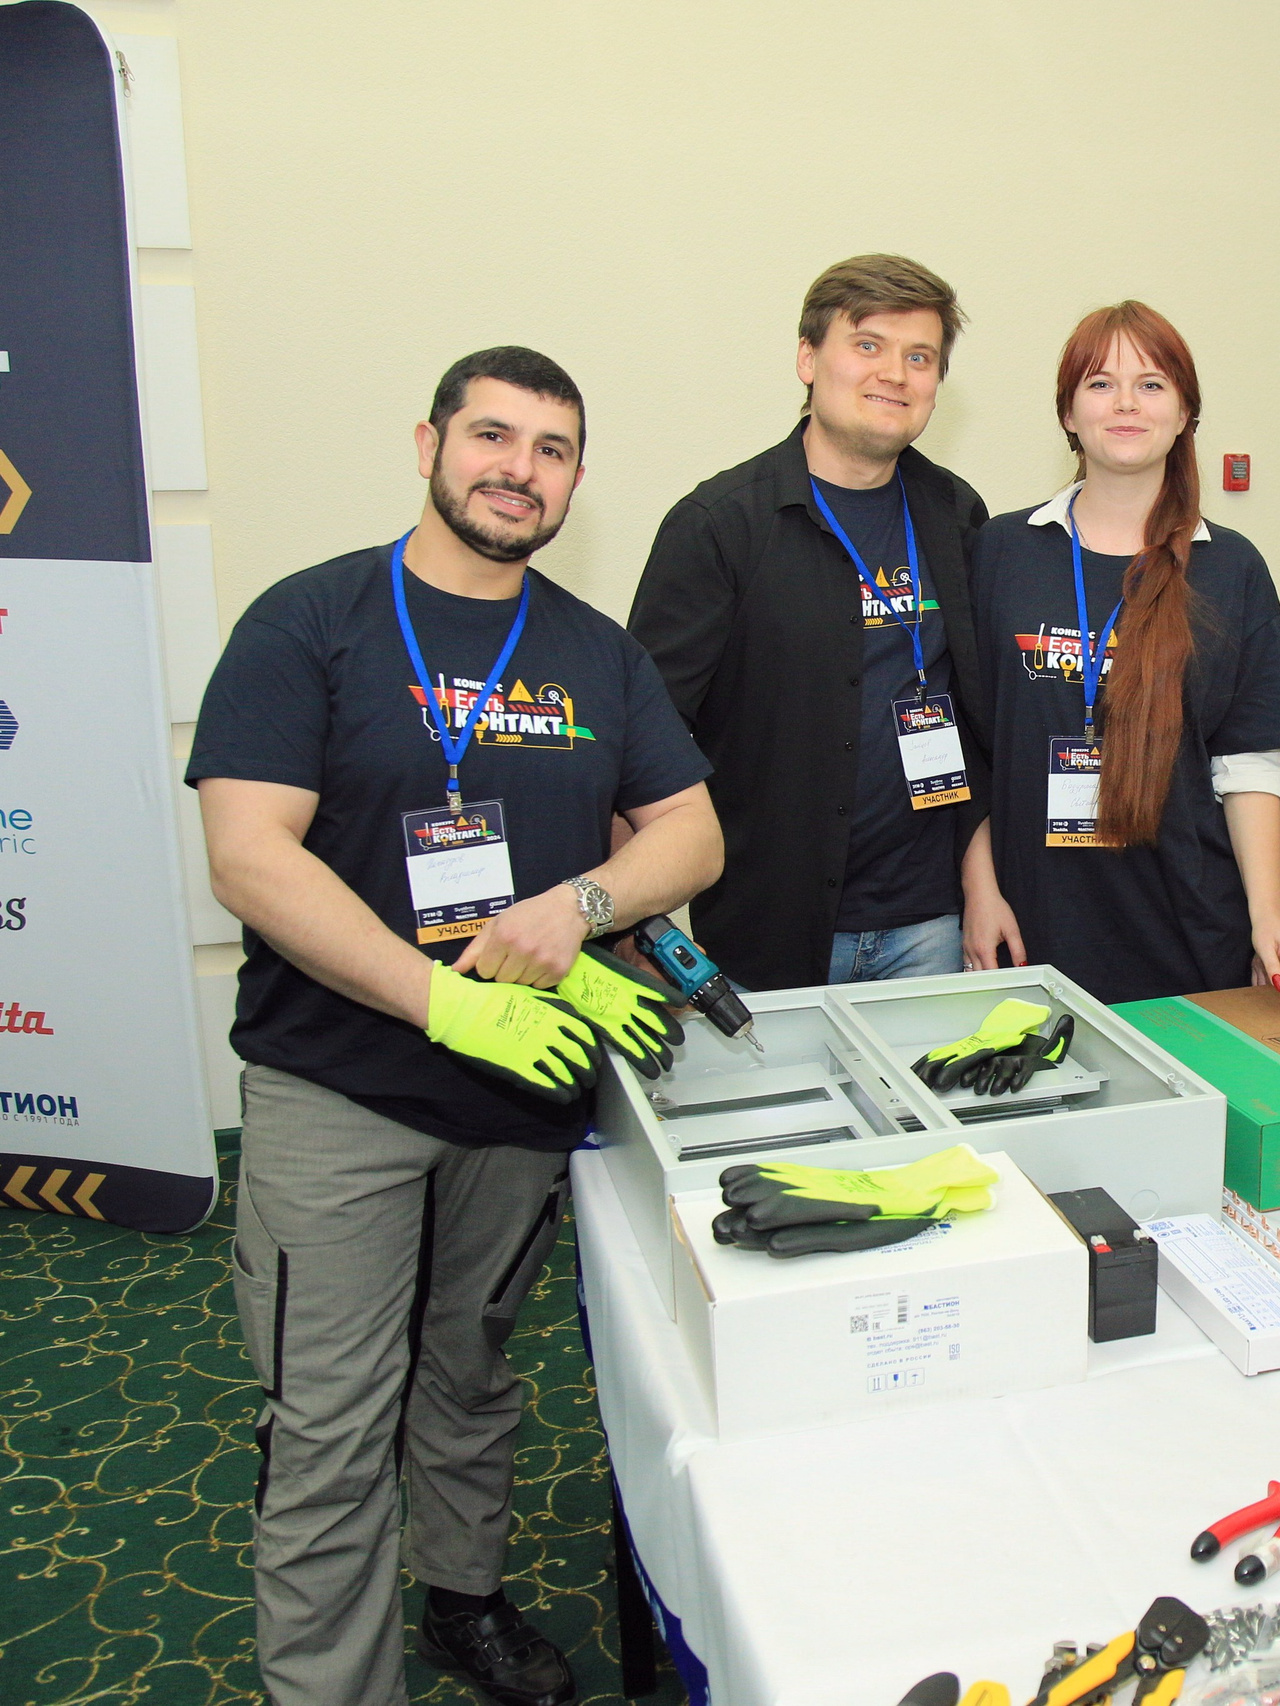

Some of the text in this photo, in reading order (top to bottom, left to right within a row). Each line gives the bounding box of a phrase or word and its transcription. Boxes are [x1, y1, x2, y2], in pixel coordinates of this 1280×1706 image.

[862, 595, 914, 617] НТАКТ
[911, 716, 941, 727] КОНТАКТ
[922, 791, 959, 804] УЧАСТНИК
[432, 826, 456, 836] Есть
[433, 828, 482, 843] КОНТАКТ
[437, 921, 486, 937] УЧАСТН
[24, 1114, 48, 1124] 1991
[53, 1116, 80, 1127] ГОДА
[927, 1300, 960, 1310] БАСТИОН
[949, 1343, 960, 1354] ISO
[867, 1359, 897, 1368] СДЕЛАНО
[905, 1354, 932, 1362] РОССИИ
